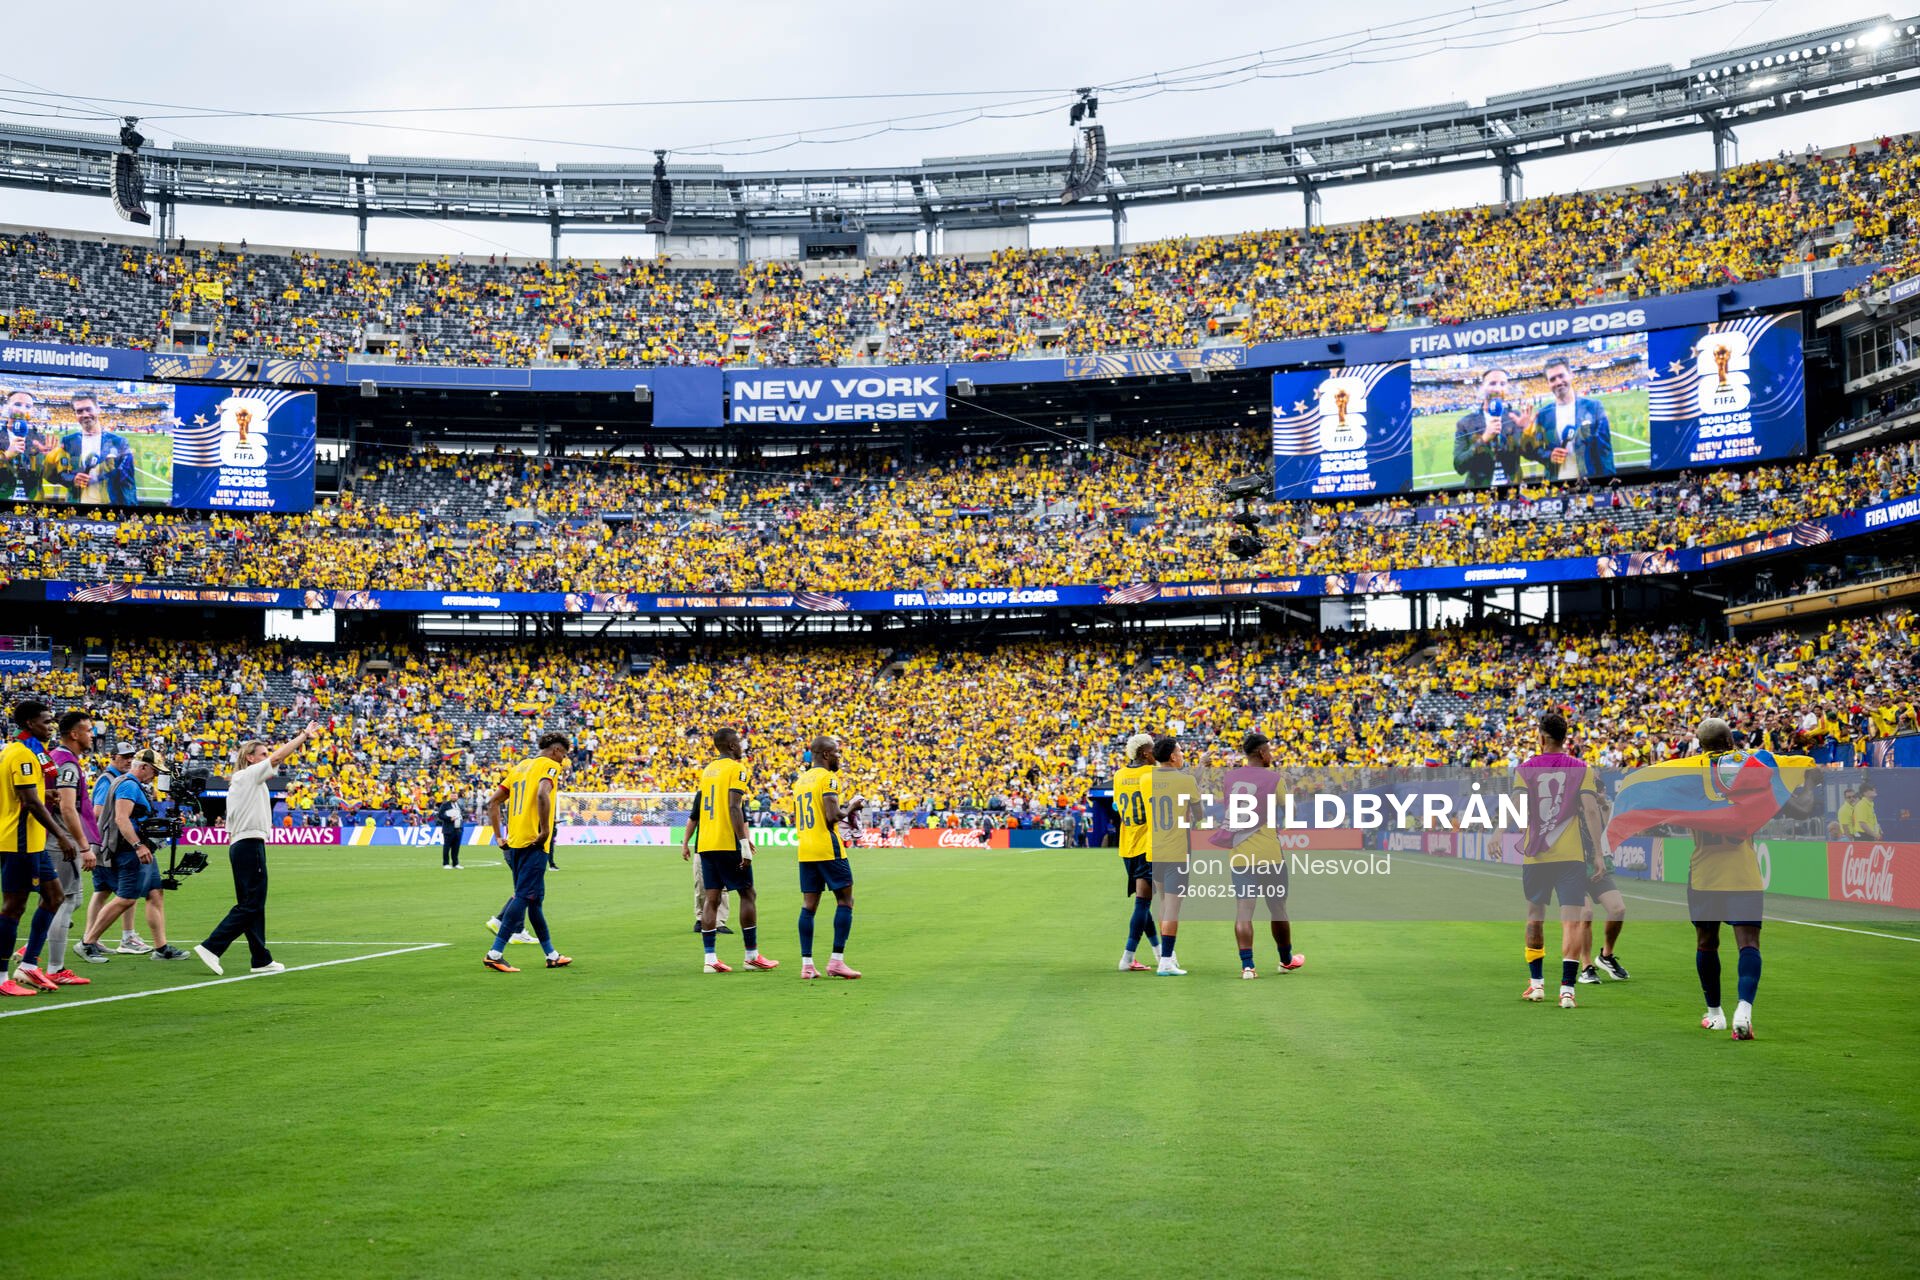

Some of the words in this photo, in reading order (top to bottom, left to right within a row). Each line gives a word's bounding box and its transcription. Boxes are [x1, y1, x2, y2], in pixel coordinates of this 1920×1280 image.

[1895, 279, 1920, 298] NEW
[1410, 333, 1451, 354] FIFA
[1453, 324, 1525, 348] WORLD
[1528, 318, 1569, 339] CUP
[1572, 308, 1646, 334] 2026
[2, 347, 109, 371] #FIFAWorldCup
[734, 380, 823, 400] NEW
[834, 377, 939, 398] YORK
[1714, 396, 1736, 405] FIFA
[734, 404, 811, 422] NEW
[813, 402, 939, 421] JERSEY
[1699, 414, 1732, 426] WORLD
[1732, 412, 1751, 422] CUP
[1699, 421, 1752, 438] 2026
[1334, 435, 1354, 443] FIFA
[1696, 441, 1722, 452] NEW
[1724, 437, 1755, 449] YORK
[234, 452, 254, 460] FIFA
[1320, 451, 1350, 461] WORLD
[1350, 450, 1368, 459] CUP
[1690, 451, 1716, 462] NEW
[1718, 445, 1762, 459] JERSEY
[219, 467, 250, 476] WORLD
[250, 468, 268, 477] CUP
[1320, 459, 1368, 473] 2026
[219, 475, 267, 488] 2026
[1312, 484, 1336, 494] NEW
[1337, 481, 1376, 492] JERSEY
[1318, 475, 1341, 485] NEW
[1342, 473, 1370, 483] YORK
[210, 496, 233, 506] NEW
[235, 498, 276, 507] JERSEY
[216, 489, 240, 498] NEW
[241, 490, 269, 499] YORK
[1865, 508, 1888, 527] FIFA
[1888, 498, 1920, 521] WORL
[131, 589, 161, 599] NEW
[163, 589, 198, 600] YORK
[200, 591, 229, 601] NEW
[230, 592, 279, 603] JERSEY
[1160, 586, 1189, 597] NEW
[1190, 585, 1222, 596] YORK
[1224, 583, 1252, 595] NEW
[1253, 580, 1301, 593] JERSEY
[657, 597, 685, 608] NEW
[686, 597, 718, 607] YORK
[719, 597, 746, 607] NEW
[747, 596, 793, 607] JERSEY
[894, 593, 925, 606] FIFA
[926, 592, 976, 605] WORLD
[978, 591, 1007, 604] CUP
[1008, 590, 1058, 603] 2026
[512, 780, 526, 816] 11
[704, 784, 715, 820] 4
[797, 792, 815, 831] 13
[1119, 790, 1147, 827] 20
[1149, 796, 1174, 832] 10
[186, 828, 229, 846] QAT
[394, 827, 444, 845] VISA
[1842, 844, 1895, 902] Coca-Cola
